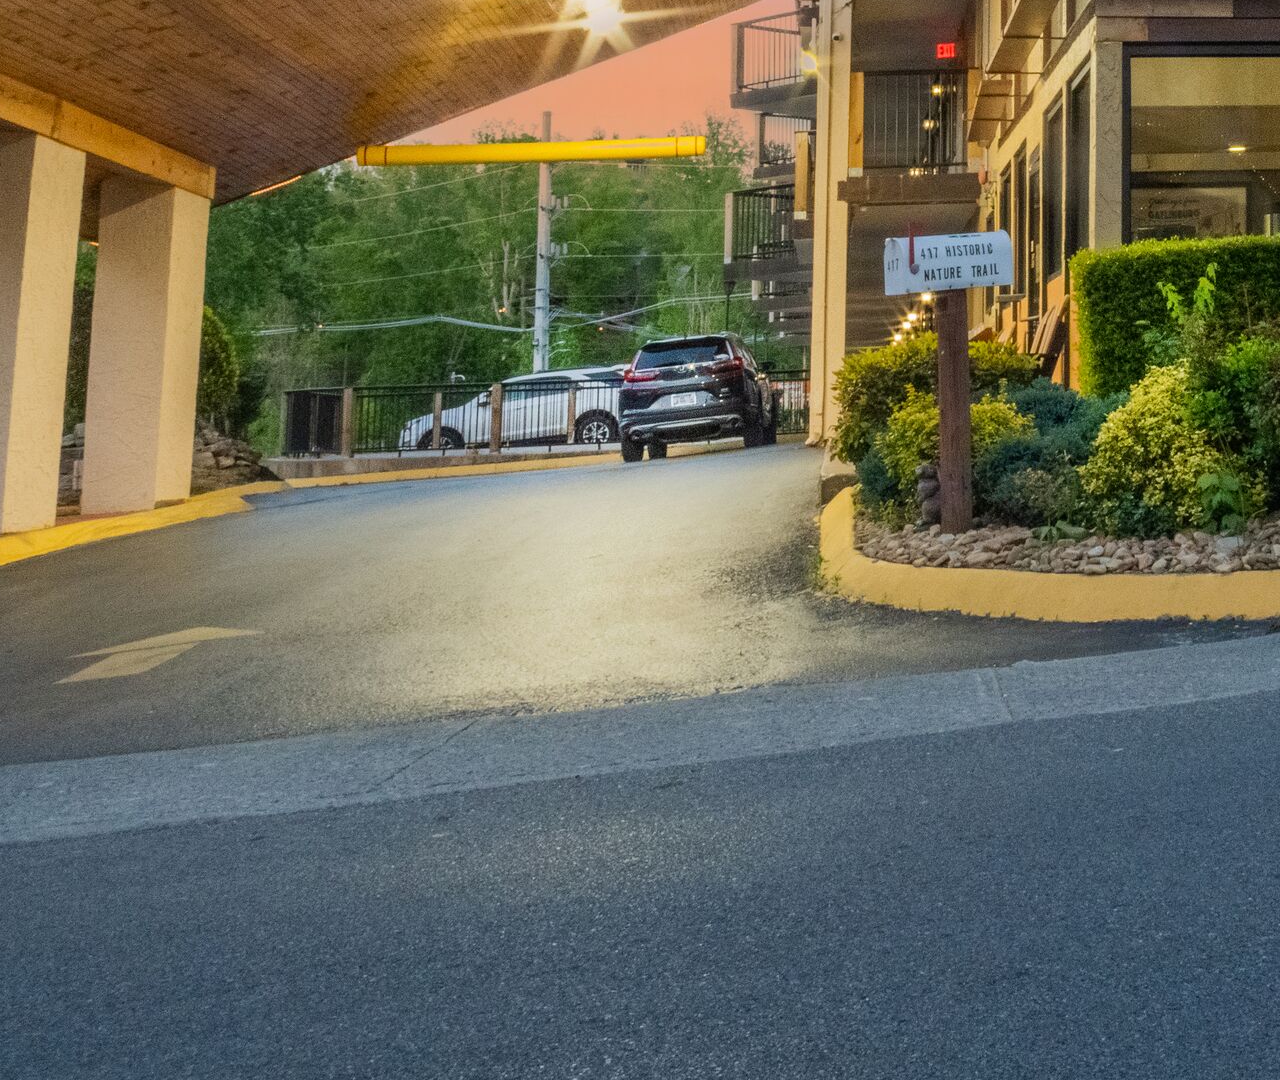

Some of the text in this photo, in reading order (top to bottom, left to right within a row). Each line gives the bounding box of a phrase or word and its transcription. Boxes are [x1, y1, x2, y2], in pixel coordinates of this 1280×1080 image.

[936, 43, 955, 58] EXIT
[921, 243, 993, 260] 417 HISTORIC
[887, 258, 899, 272] 417
[924, 263, 999, 282] NATURE TRAIL
